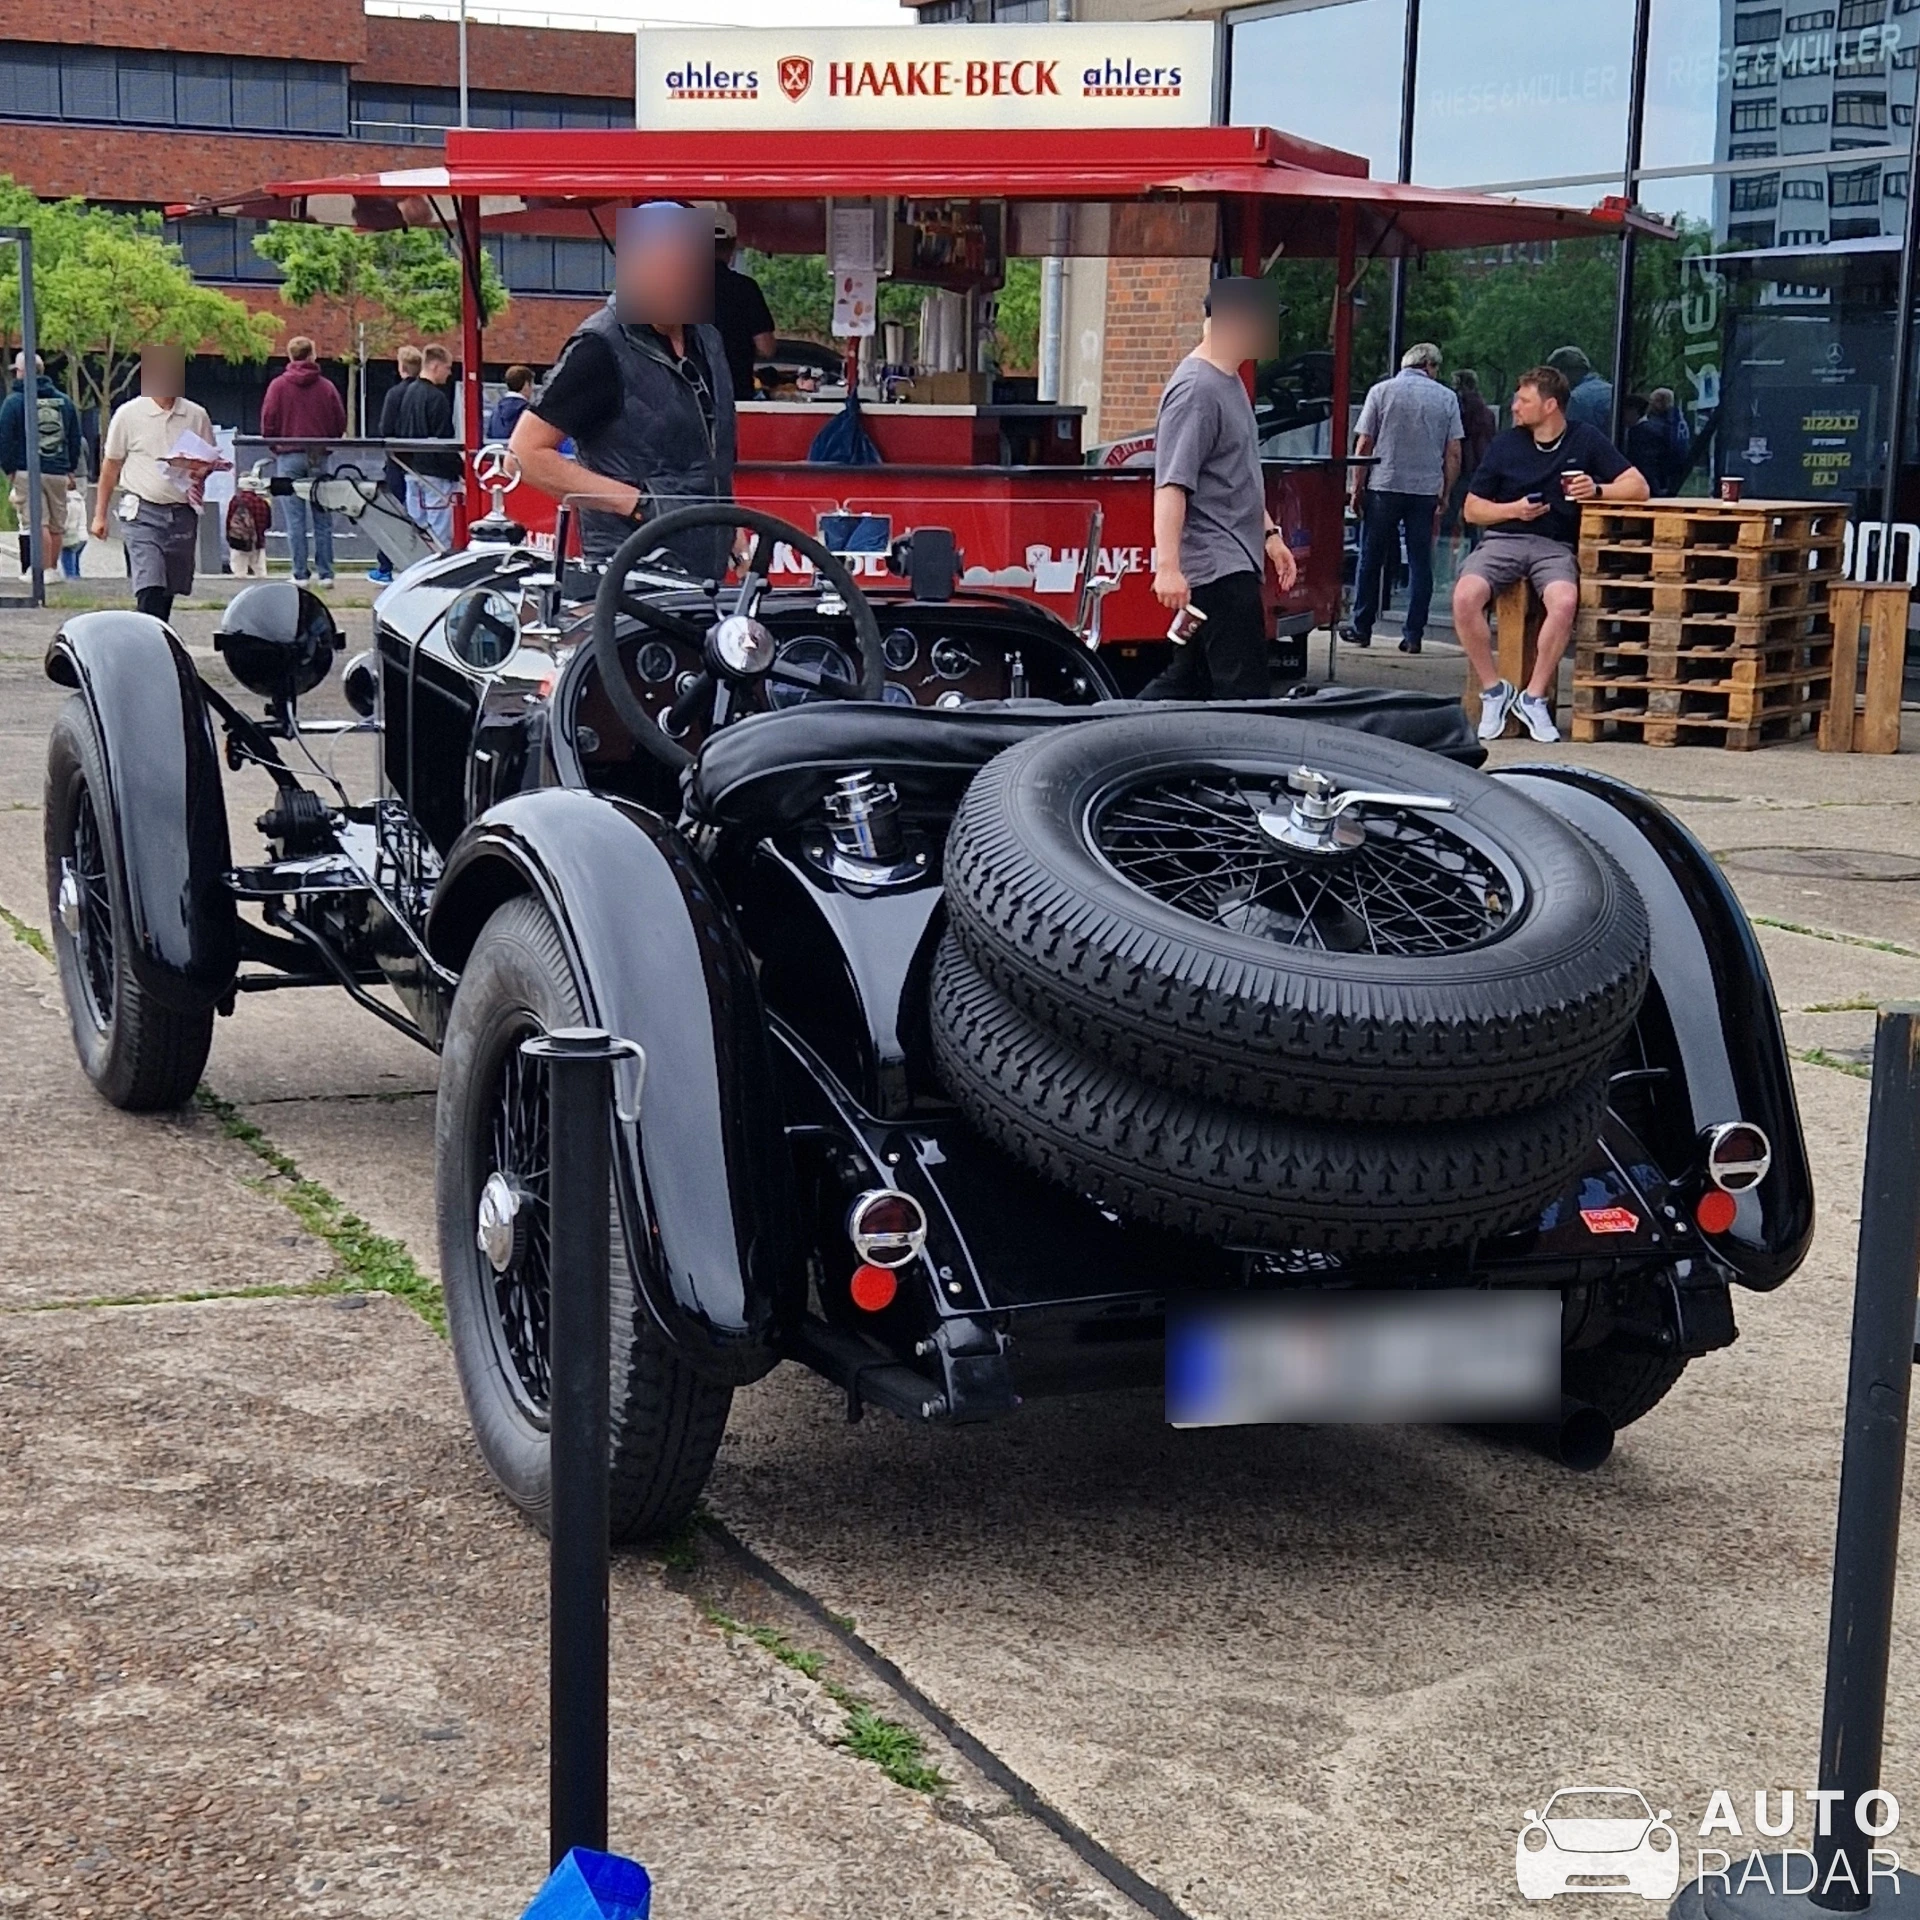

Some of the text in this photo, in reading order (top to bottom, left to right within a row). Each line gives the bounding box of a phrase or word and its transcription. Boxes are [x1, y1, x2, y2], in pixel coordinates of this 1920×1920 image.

[665, 60, 759, 88] ahlers
[829, 60, 1062, 97] HAAKE-BECK
[1083, 57, 1182, 85] ahlers
